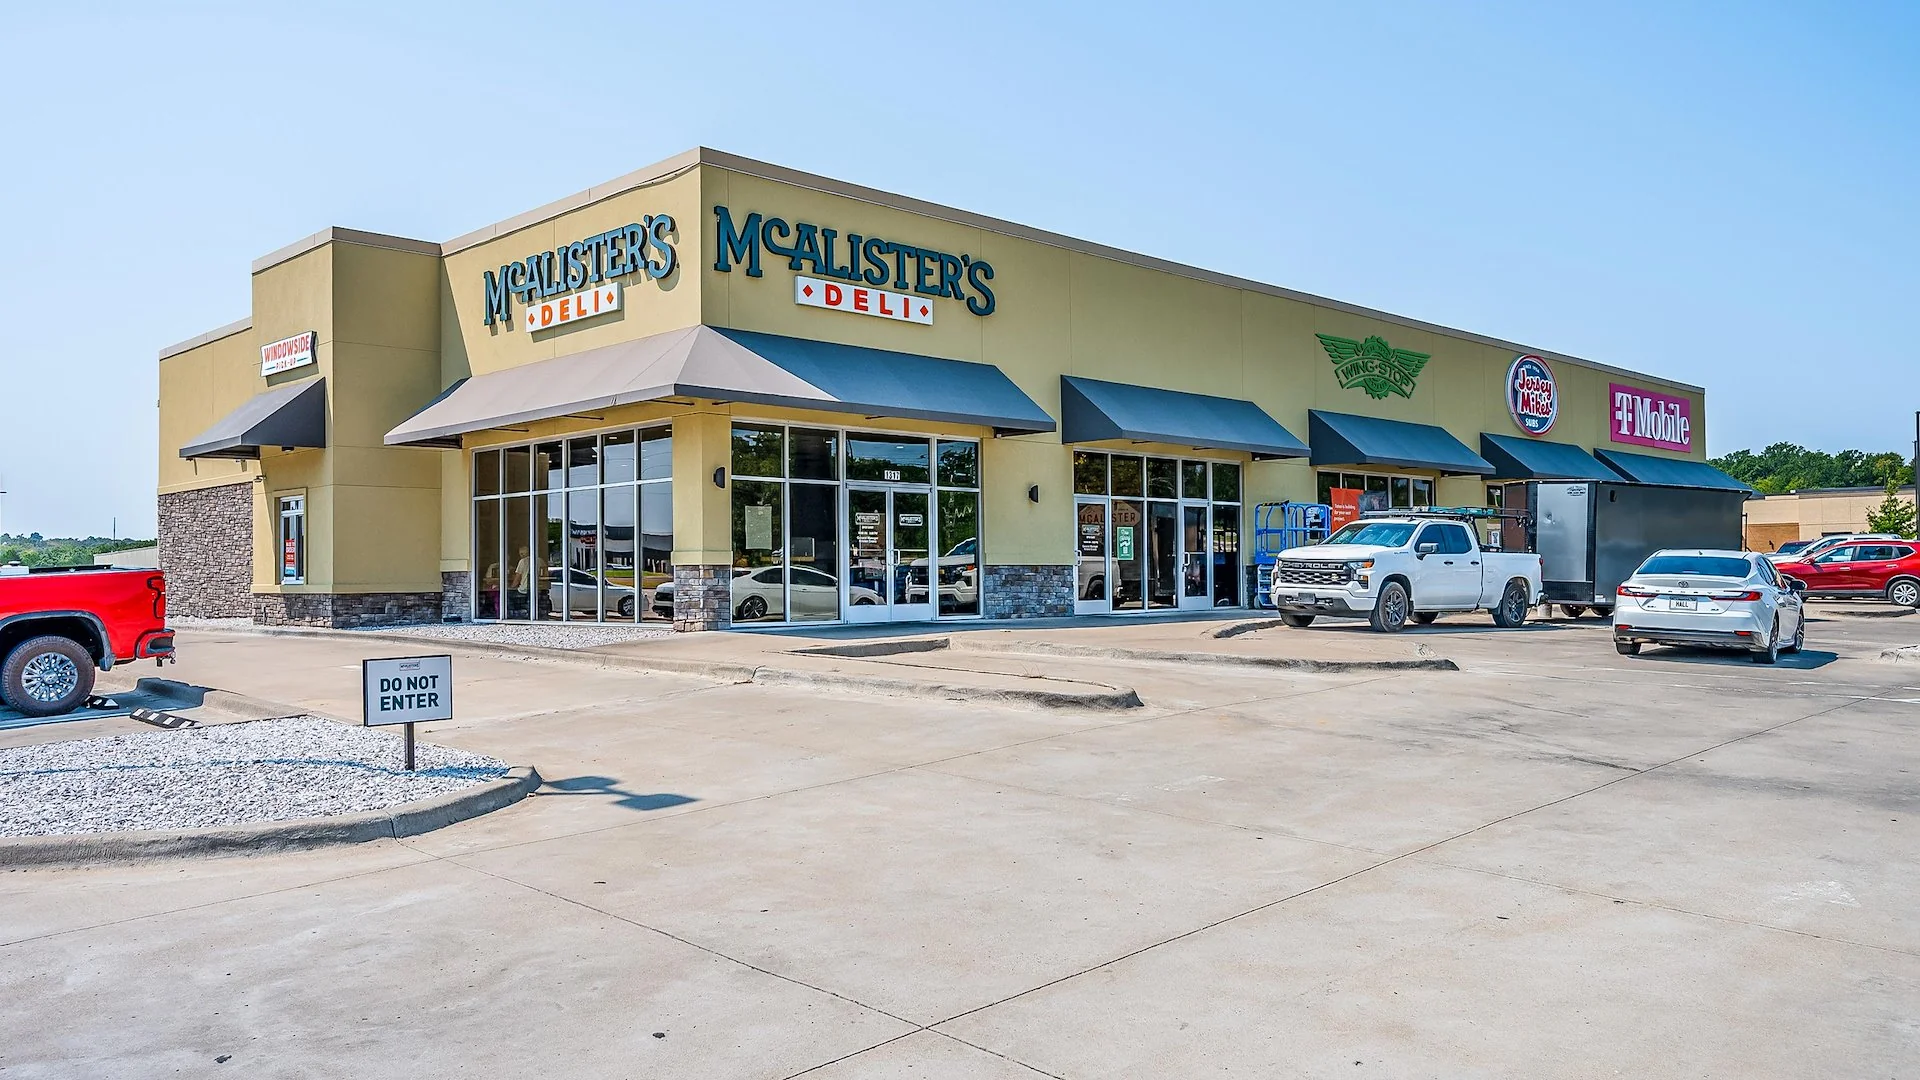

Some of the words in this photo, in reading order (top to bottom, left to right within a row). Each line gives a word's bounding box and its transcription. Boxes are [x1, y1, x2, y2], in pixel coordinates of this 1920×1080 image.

[541, 291, 599, 327] DELI
[825, 284, 909, 318] DELI
[264, 335, 310, 363] WINDOWSIDE
[275, 357, 296, 370] PICK-UP
[1518, 368, 1552, 400] Jersey
[1525, 418, 1539, 428] SUBS
[1080, 512, 1136, 523] MCALSTER
[380, 677, 402, 693] DO
[407, 675, 439, 691] NOT
[380, 693, 439, 711] ENTER
